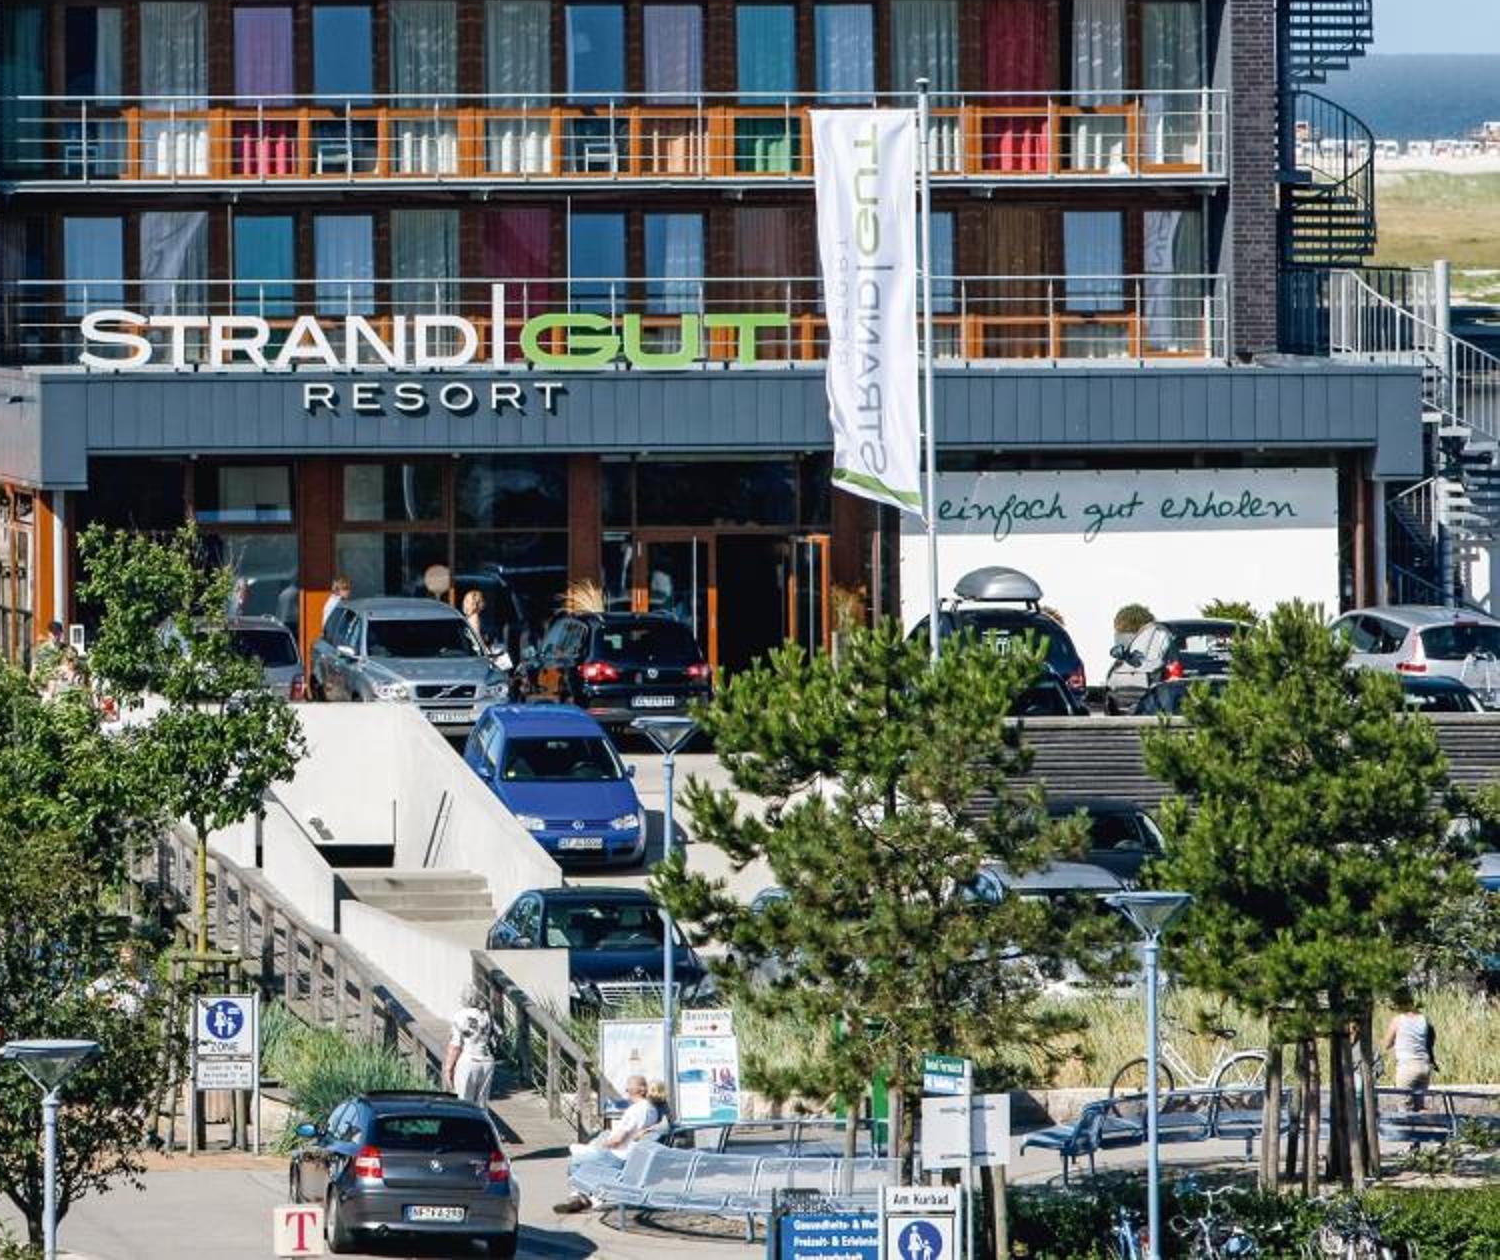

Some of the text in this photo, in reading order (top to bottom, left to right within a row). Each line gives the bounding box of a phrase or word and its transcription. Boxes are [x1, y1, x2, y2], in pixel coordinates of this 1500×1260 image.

[303, 383, 564, 410] RESORT
[938, 490, 1299, 543] einfach gut erholen
[893, 1193, 948, 1205] Am Kurbad
[285, 1212, 316, 1251] T
